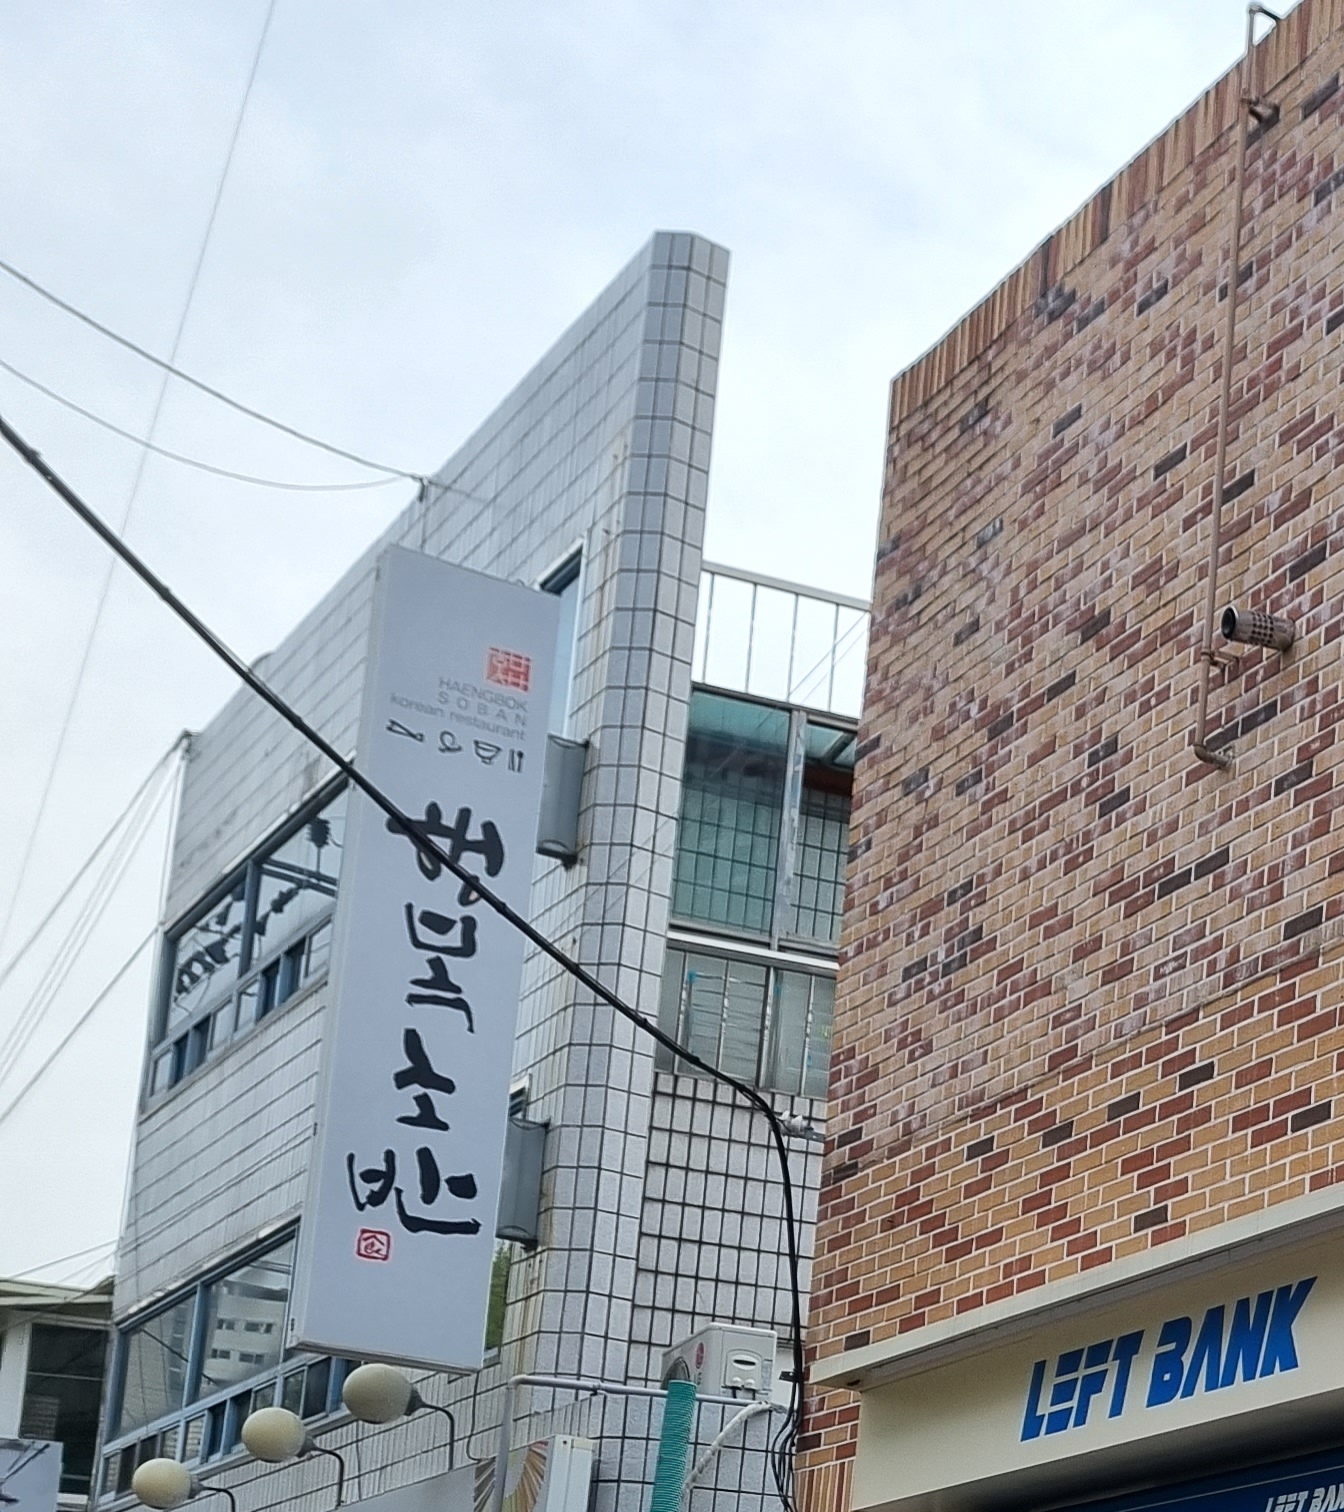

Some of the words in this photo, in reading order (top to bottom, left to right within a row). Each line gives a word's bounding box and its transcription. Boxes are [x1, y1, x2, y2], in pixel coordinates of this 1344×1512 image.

[346, 801, 506, 1236] 행복소반
[1019, 1329, 1145, 1443] LEFT
[1145, 1275, 1318, 1409] BANK
